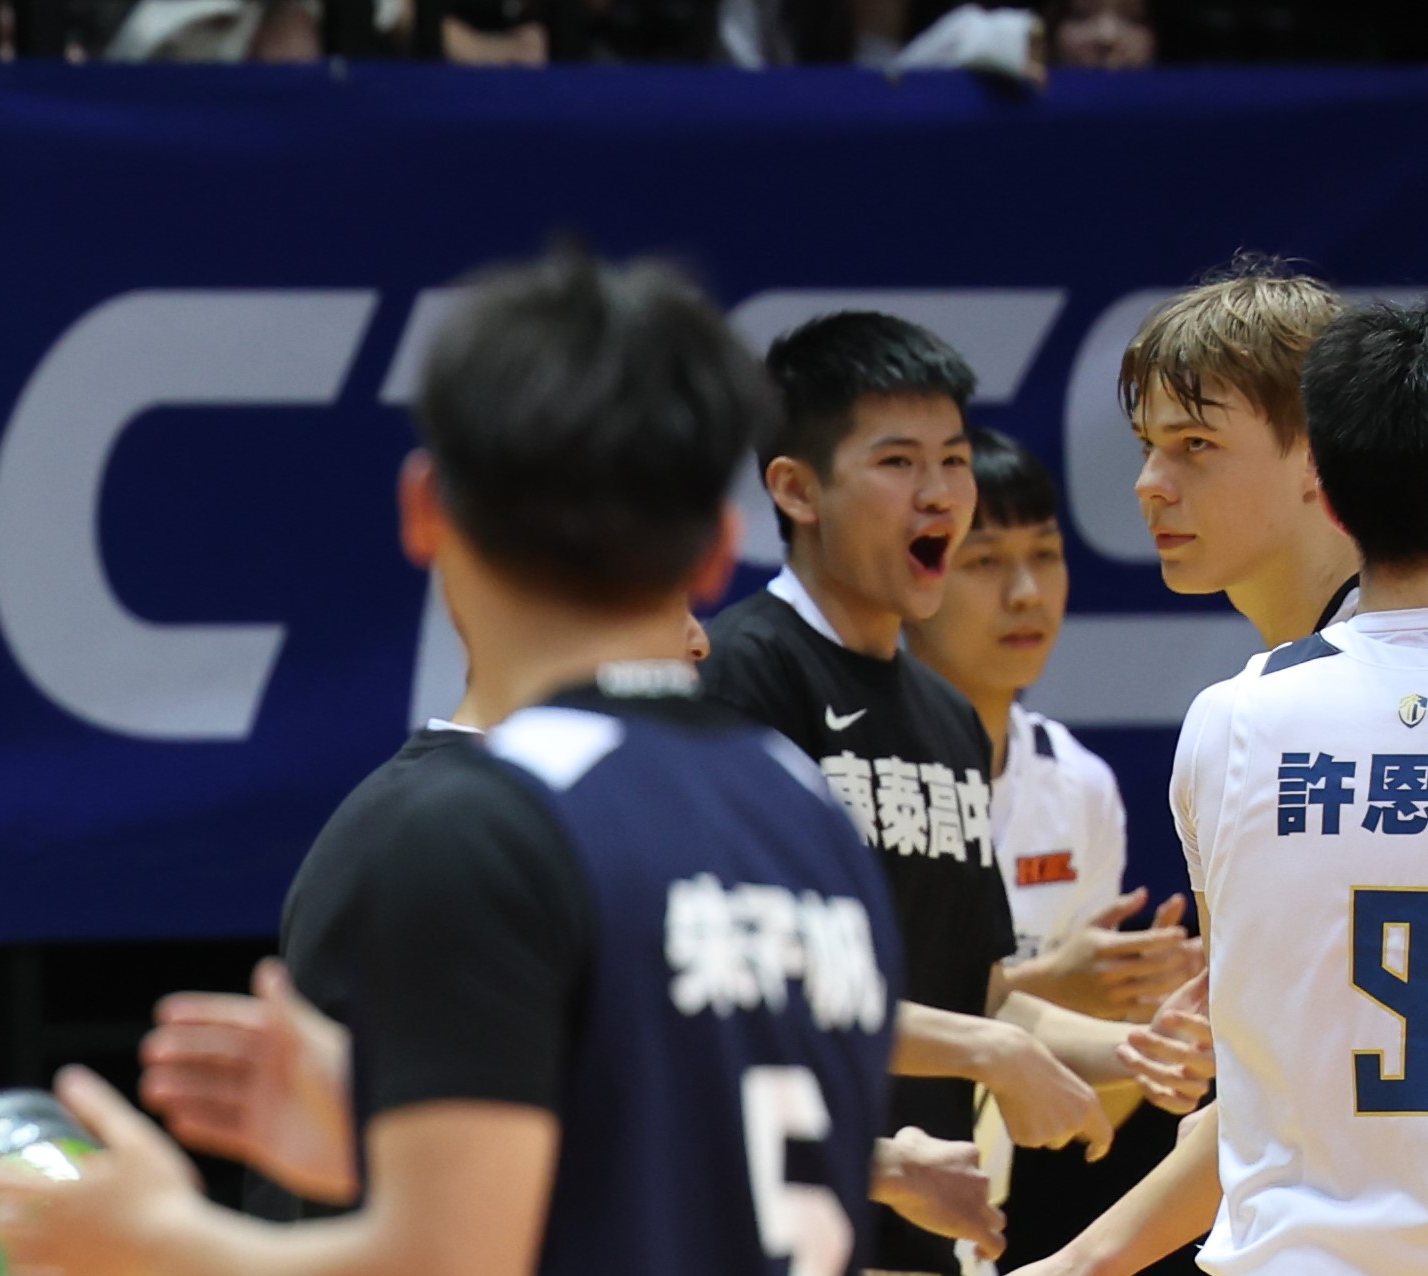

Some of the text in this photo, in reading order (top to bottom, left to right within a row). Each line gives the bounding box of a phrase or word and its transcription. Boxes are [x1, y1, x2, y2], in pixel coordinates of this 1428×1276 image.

[820, 750, 993, 868] 東泰高中
[1350, 885, 1428, 1116] 9
